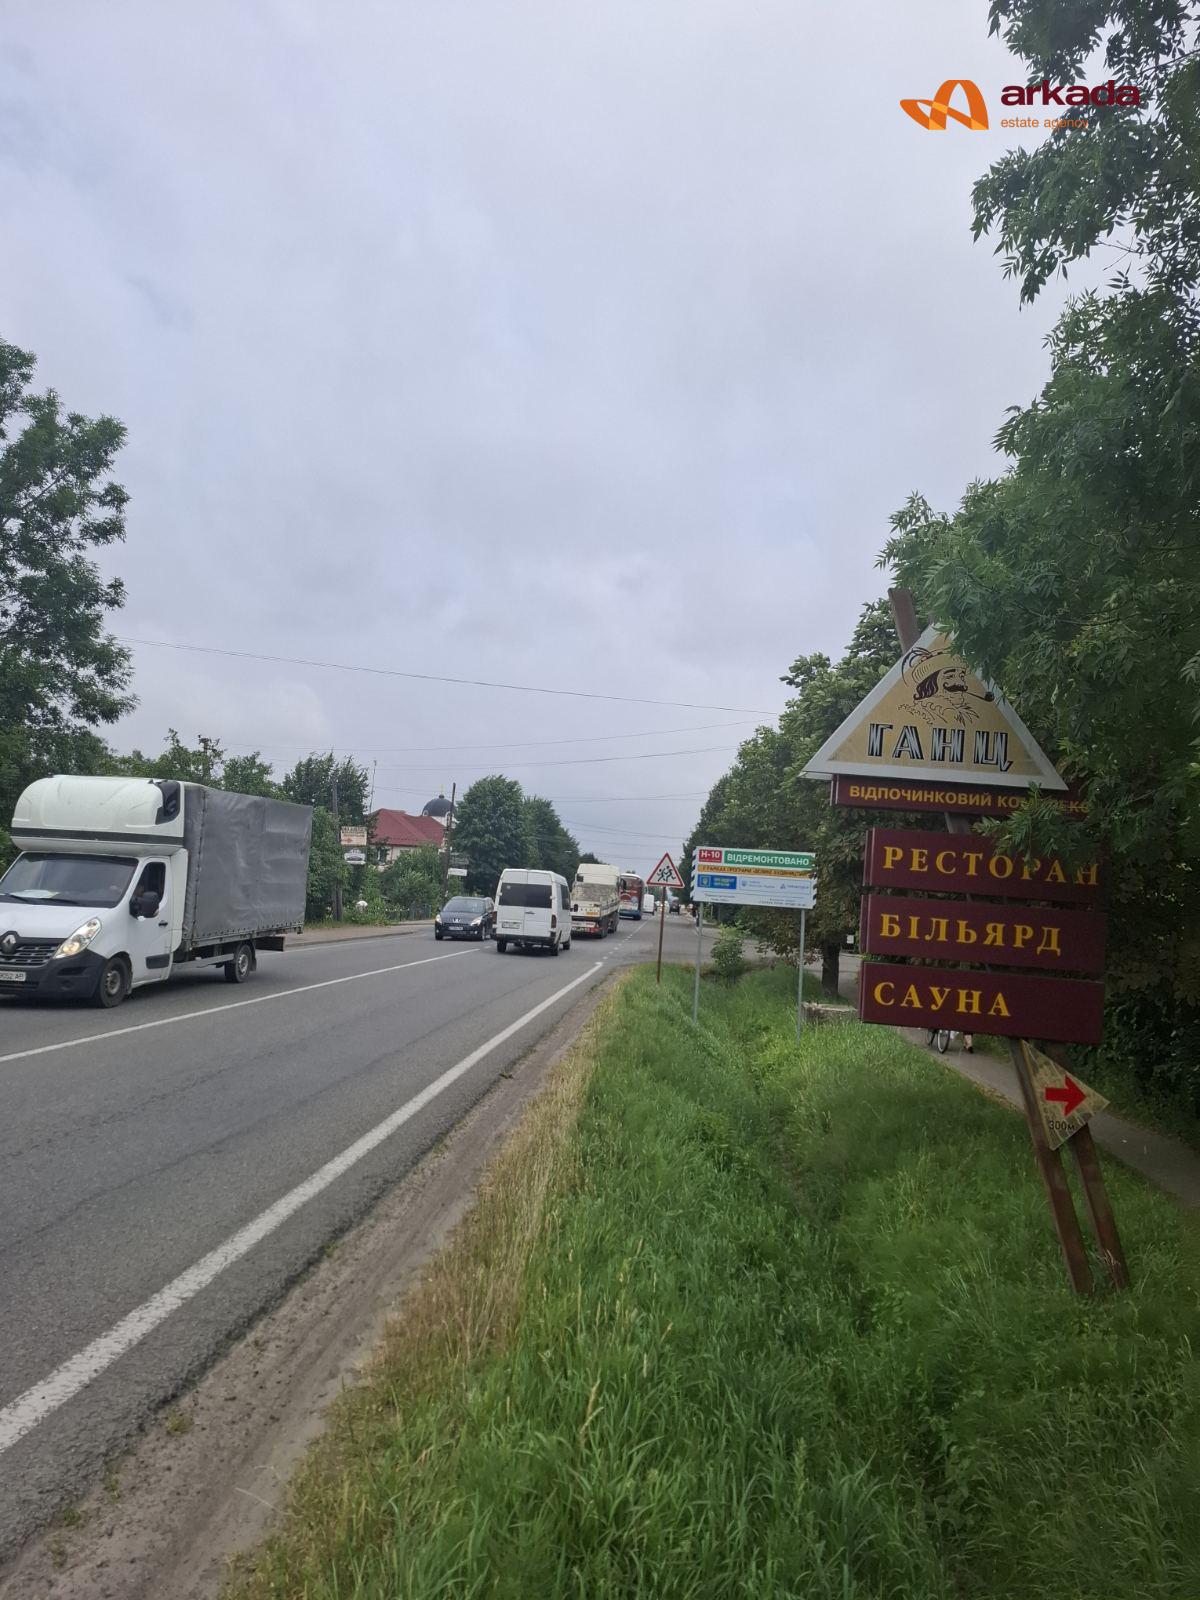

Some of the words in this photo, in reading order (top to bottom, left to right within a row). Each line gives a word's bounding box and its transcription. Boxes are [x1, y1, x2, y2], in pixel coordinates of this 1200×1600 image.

[849, 785, 992, 807] ВІДПОЧИНКОВИЙ
[700, 849, 721, 859] Н-10
[726, 853, 810, 866] ВІДРЕМОНТОВАНО
[883, 846, 1100, 885] РЕСТОРАН
[880, 913, 1061, 957] БІЛЬЯРД
[873, 981, 1011, 1017] САУНА
